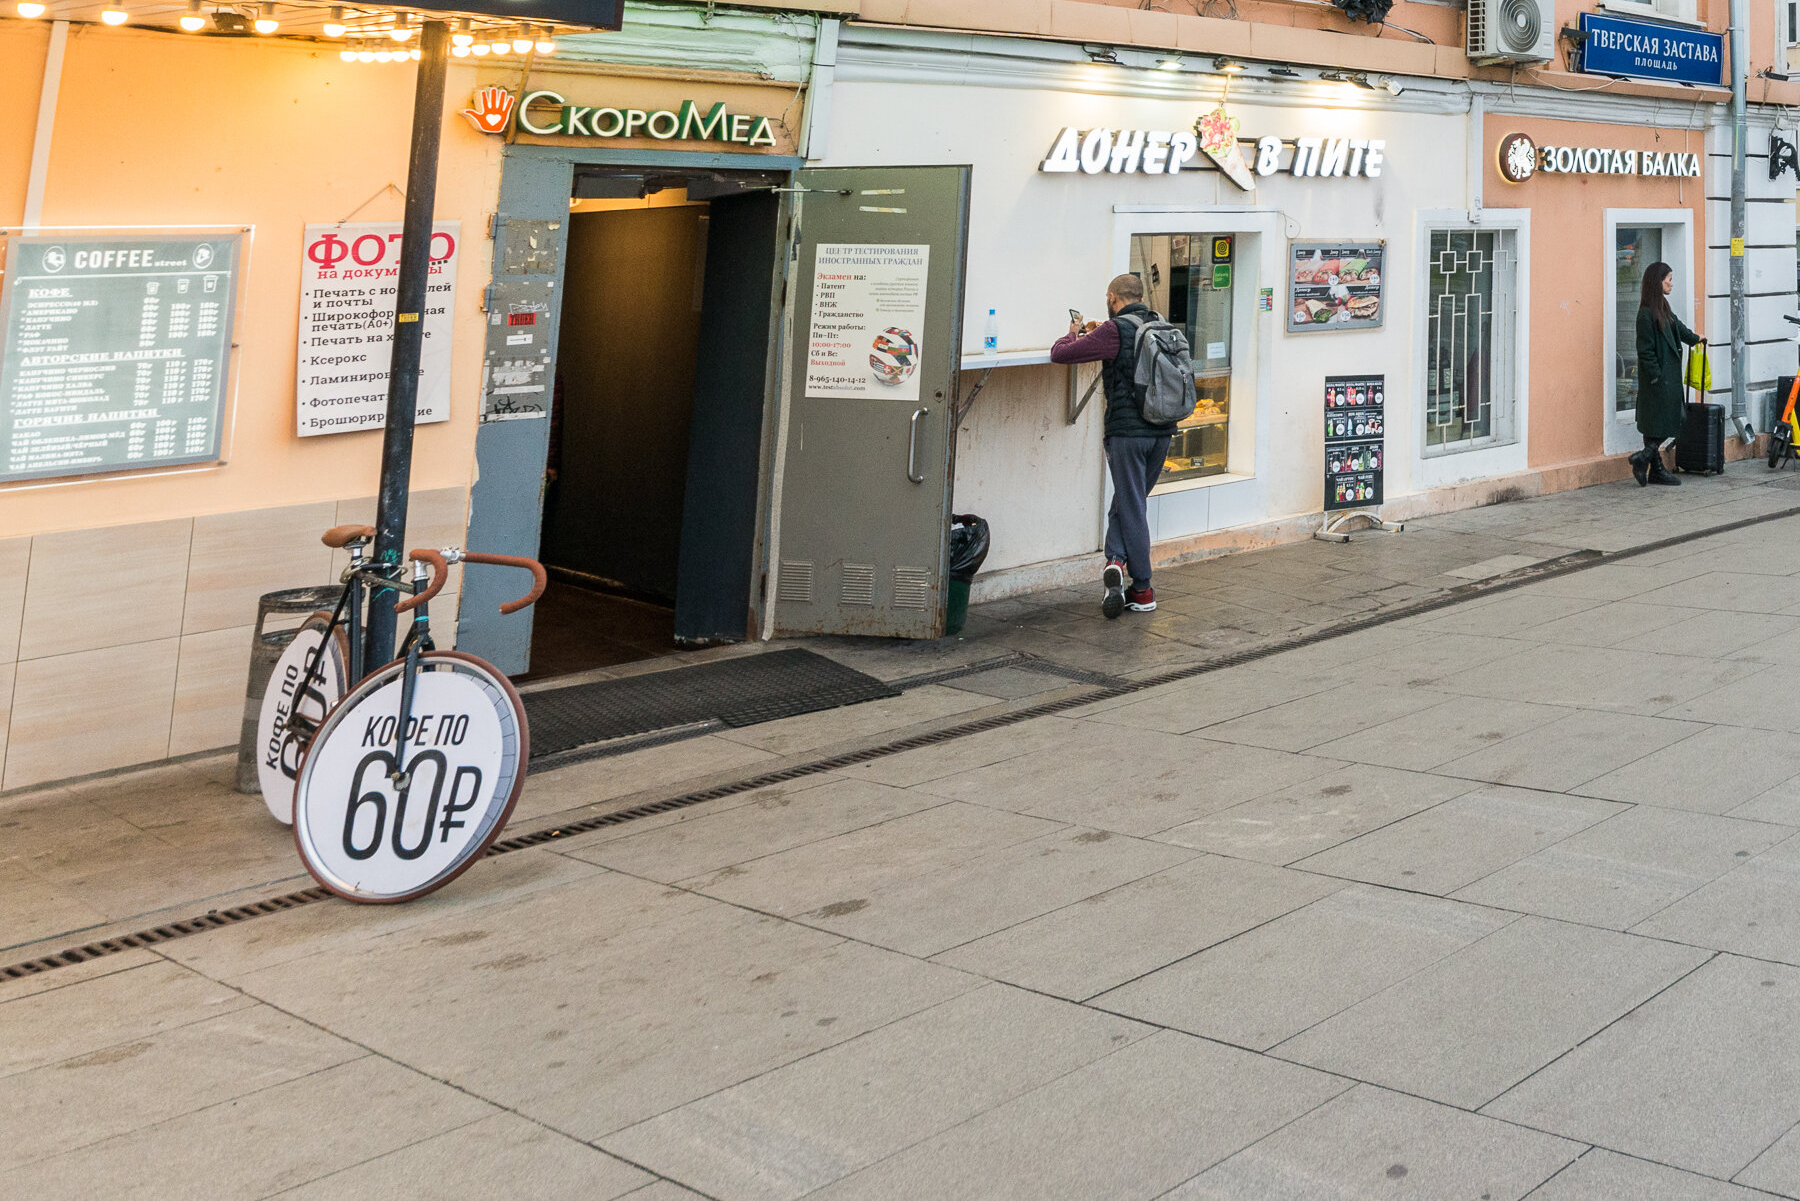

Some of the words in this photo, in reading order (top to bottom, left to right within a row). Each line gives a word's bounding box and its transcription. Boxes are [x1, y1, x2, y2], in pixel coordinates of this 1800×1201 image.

[1592, 28, 1659, 55] ТВЕРСКАЯ
[1663, 39, 1718, 63] ЗАСТАВА
[1635, 57, 1678, 71] ПЛОЩАДЬ
[1042, 127, 1198, 175] ДОНЕР
[1255, 135, 1283, 177] В
[1292, 137, 1386, 178] ПИТЕ
[1543, 146, 1636, 175] ЗОЛОТАЯ
[1642, 152, 1701, 177] БАЛКА
[74, 250, 155, 268] COFFEE
[154, 259, 187, 267] street
[855, 247, 918, 255] ТЕСТИРОВАНИЯ
[317, 271, 337, 279] на
[342, 266, 442, 280] докумы
[29, 288, 70, 298] КОФЕ
[314, 288, 365, 298] Печать
[380, 282, 451, 294] нолей
[327, 299, 373, 308] почты
[311, 336, 363, 346] Печать
[21, 353, 110, 366] АВТОРСКИЕ
[113, 348, 184, 361] НАПИТКИ
[310, 354, 367, 366] Ксерокс
[14, 414, 83, 429] ГОРЯЧИЕ
[88, 408, 159, 422] НАПИТКИ
[310, 408, 433, 428] Брошюририе
[282, 664, 298, 697] ПО
[434, 714, 469, 746] ПО
